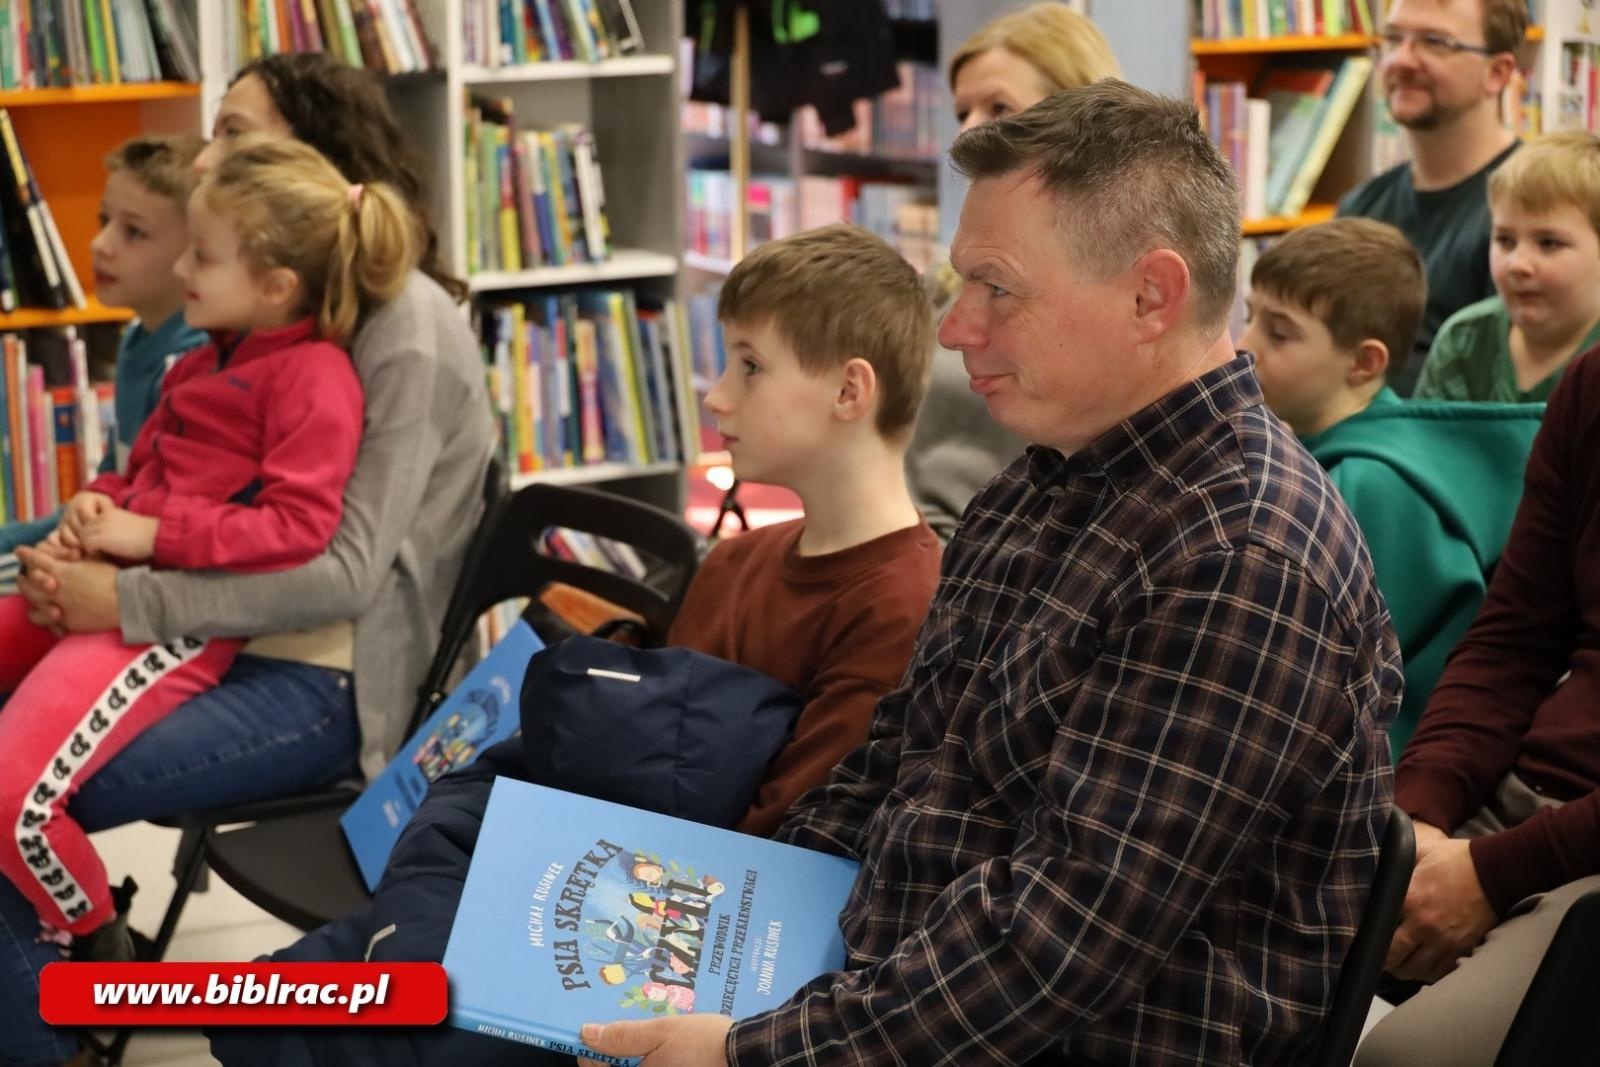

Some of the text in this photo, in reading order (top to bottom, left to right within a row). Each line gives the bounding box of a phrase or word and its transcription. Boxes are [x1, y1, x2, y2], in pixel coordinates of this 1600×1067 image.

[528, 860, 565, 948] MICHAŁ RUSINEK
[553, 838, 624, 991] PSIA SKRĘTKA
[708, 912, 731, 976] PRZEWODNIK
[731, 869, 758, 955] PRZEKLEŃSTWACH
[757, 920, 783, 996] JOANNA RUSINEK
[507, 1030, 547, 1048] RUSINEK
[550, 1041, 574, 1055] PSIA
